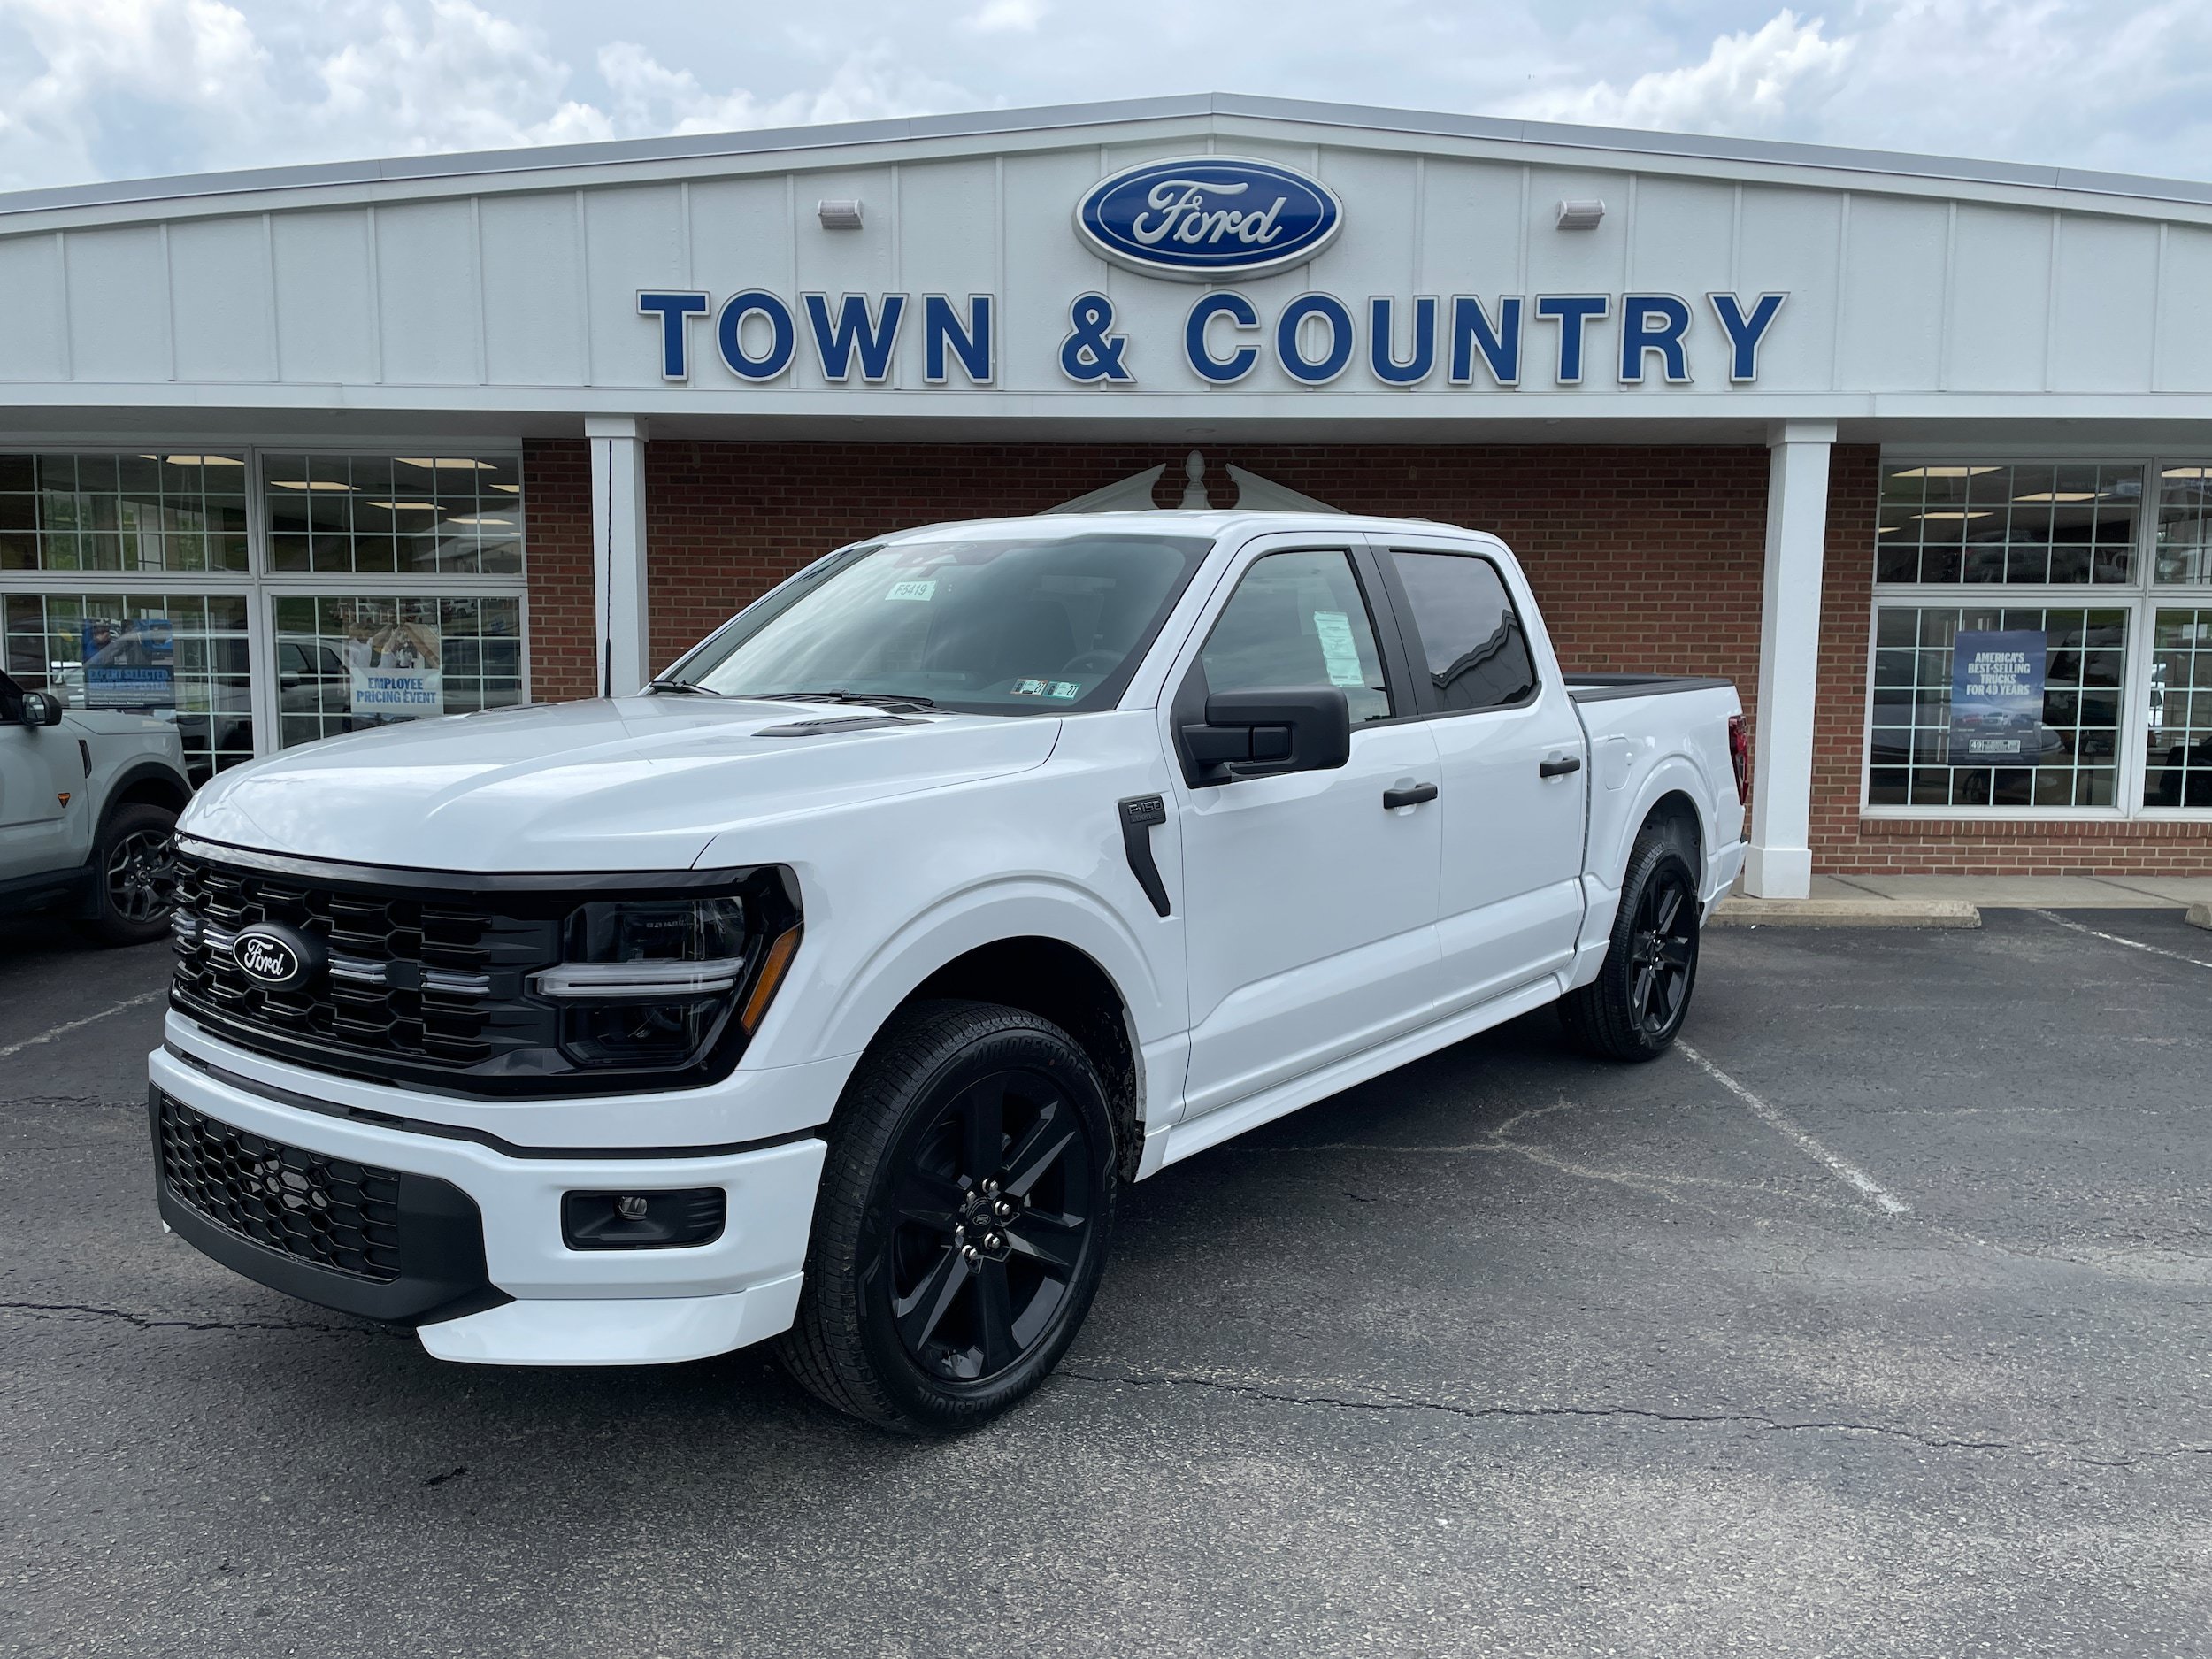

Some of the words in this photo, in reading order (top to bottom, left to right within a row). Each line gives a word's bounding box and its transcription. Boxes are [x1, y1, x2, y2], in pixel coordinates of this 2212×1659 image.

[1132, 179, 1288, 244] Ford
[636, 288, 994, 384] TOWN
[1059, 290, 1139, 384] &
[1184, 289, 1790, 386] COUNTRY
[895, 583, 928, 595] F5419
[1975, 652, 2025, 663] AMERICA'S
[1967, 663, 2031, 674] BEST-SELLING
[367, 677, 424, 689] EMPLOYEE
[1980, 674, 2016, 684] TRUCKS
[1966, 685, 1985, 695] FOR
[1985, 685, 1998, 695] 49
[2000, 685, 2030, 695] YEARS
[357, 690, 401, 703] PRICING
[403, 691, 437, 703] EVENT
[1127, 800, 1163, 814] F-150
[243, 938, 284, 976] Ford
